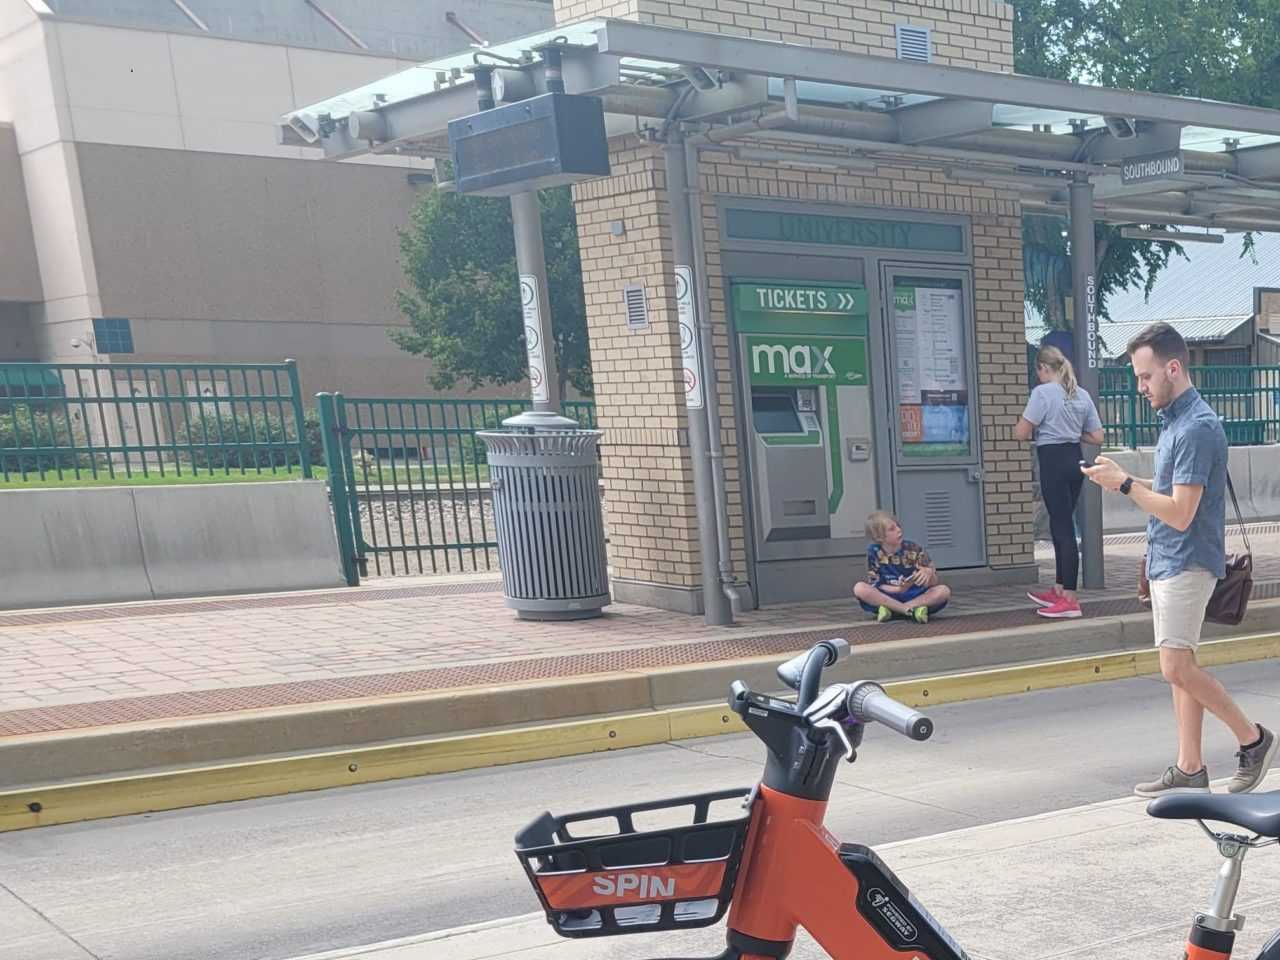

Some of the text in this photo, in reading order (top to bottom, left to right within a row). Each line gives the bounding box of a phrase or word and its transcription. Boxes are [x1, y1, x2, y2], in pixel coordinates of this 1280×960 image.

[1123, 156, 1180, 180] SOUTHBOUND
[779, 214, 911, 248] UNIVERSITY
[756, 288, 828, 310] TICKETS
[1087, 275, 1096, 369] SOUTHBOUND
[752, 344, 836, 375] max
[592, 873, 676, 899] SPIN
[882, 906, 910, 935] SEGWAY
